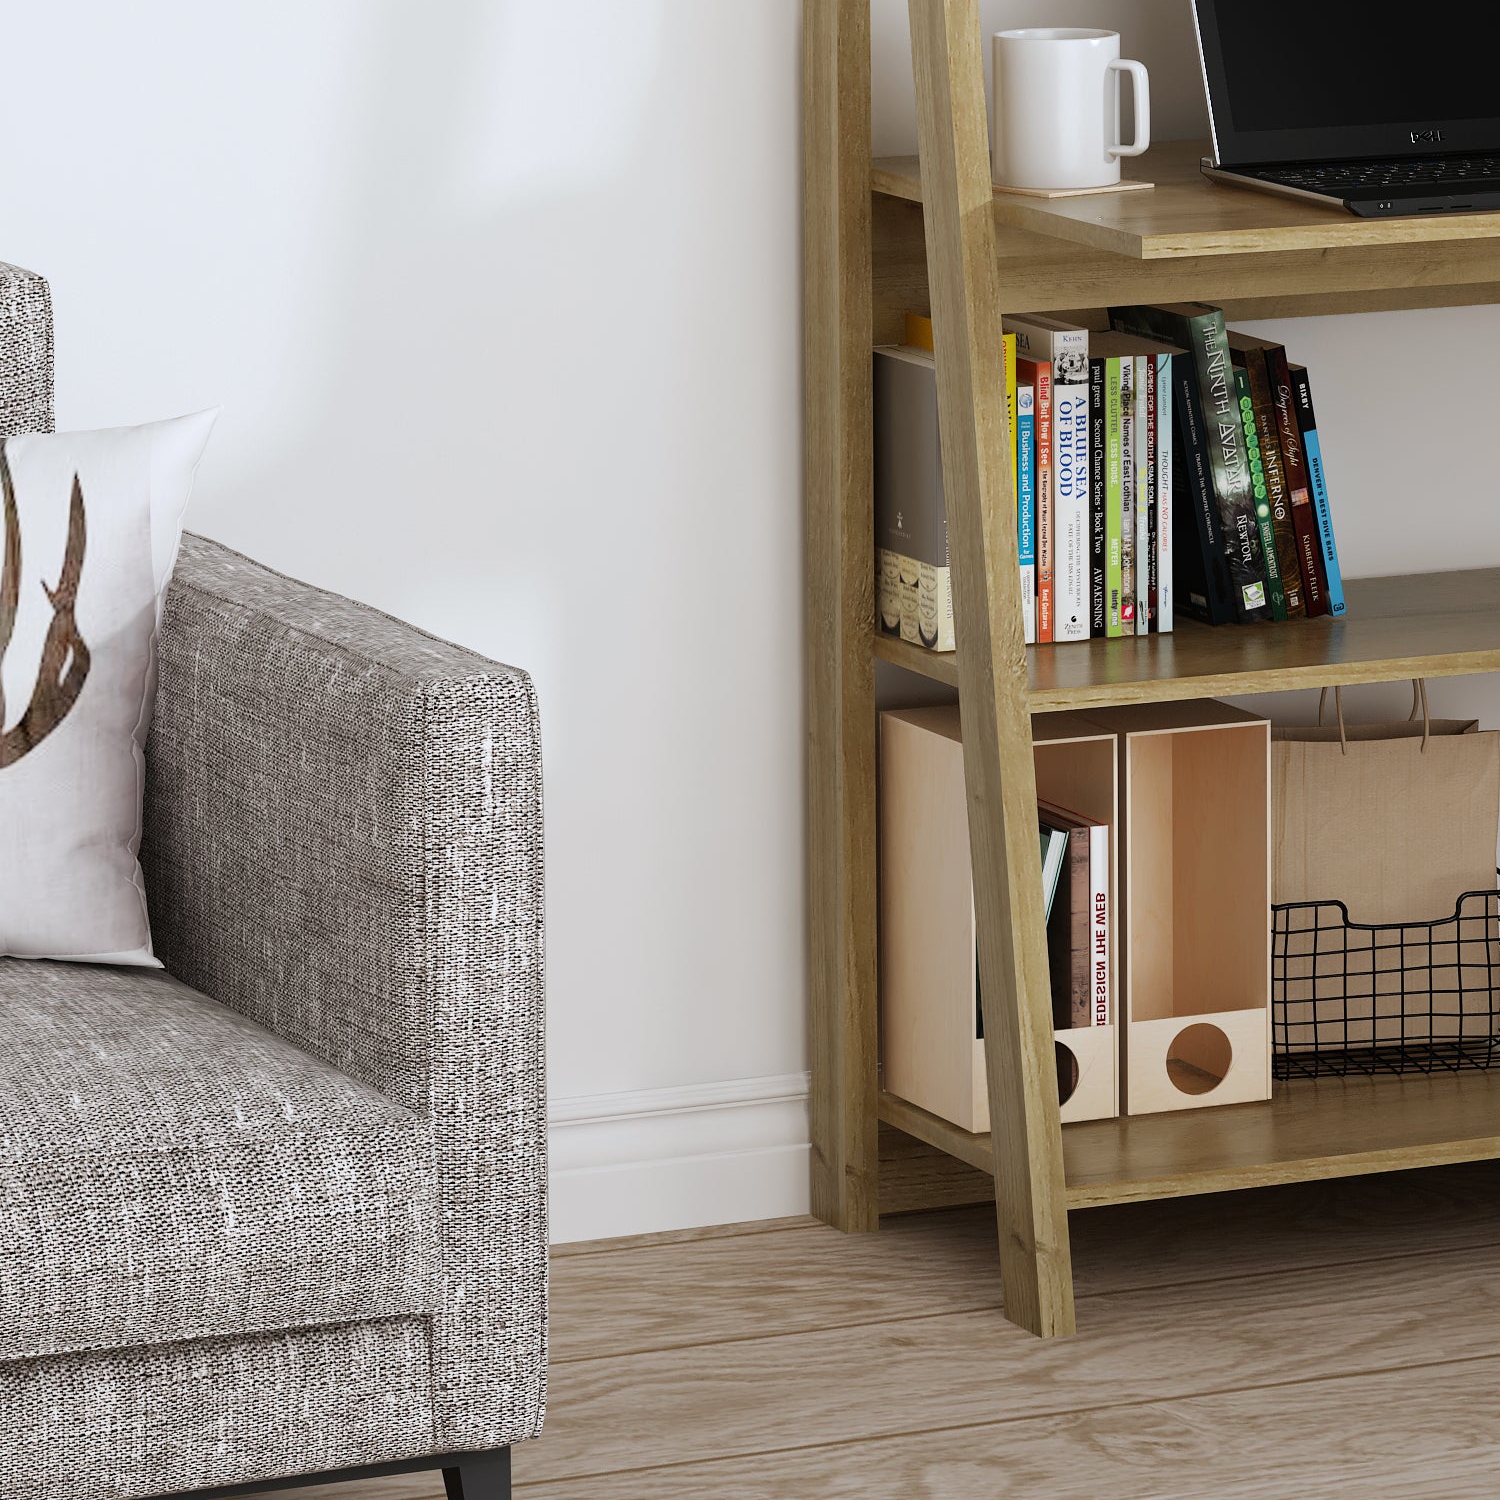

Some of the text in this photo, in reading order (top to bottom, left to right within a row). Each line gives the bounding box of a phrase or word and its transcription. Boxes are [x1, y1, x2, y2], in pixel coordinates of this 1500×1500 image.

[1411, 130, 1445, 143] DELL
[1016, 332, 1030, 350] SEA
[1040, 377, 1049, 400] Blind
[1092, 366, 1102, 408] paul green
[1122, 365, 1130, 391] Viking
[1040, 402, 1049, 418] But
[1203, 322, 1218, 351] THE
[1218, 422, 1241, 496] AVATAR
[1299, 383, 1309, 409] BIXBY
[1041, 422, 1049, 439] Now
[1094, 419, 1102, 447] Second
[1186, 399, 1194, 426] ADVENTURE
[1190, 427, 1198, 445] COMICS
[1275, 385, 1299, 467] Degrees of Sight
[1022, 431, 1031, 471] Business
[1041, 448, 1049, 464] See
[1060, 401, 1072, 496] OF BLOOD
[1075, 396, 1087, 499] A BLUE SEA
[1123, 449, 1131, 457] of
[1094, 450, 1102, 479] Chance
[1123, 460, 1131, 478] East
[1022, 474, 1030, 492] and
[1094, 482, 1102, 505] Series
[1123, 481, 1131, 512] Lothian
[1265, 450, 1286, 520] INFERNO
[1023, 495, 1032, 548] Production
[1162, 507, 1168, 520] NO
[1201, 488, 1209, 512] VAMPIRE
[1205, 513, 1214, 544] CHRONICLE
[1312, 458, 1334, 561] DENVER'S BEST DIVE BARS
[1068, 538, 1073, 547] OF
[1236, 514, 1252, 565] NEWTON
[1260, 521, 1271, 542] JENNIFER
[1123, 555, 1131, 593] Johnstone
[1265, 547, 1277, 579] ARMENTROUT
[1302, 535, 1319, 601] KIMBERLY FLEEK
[1094, 568, 1102, 628] AWAKENING
